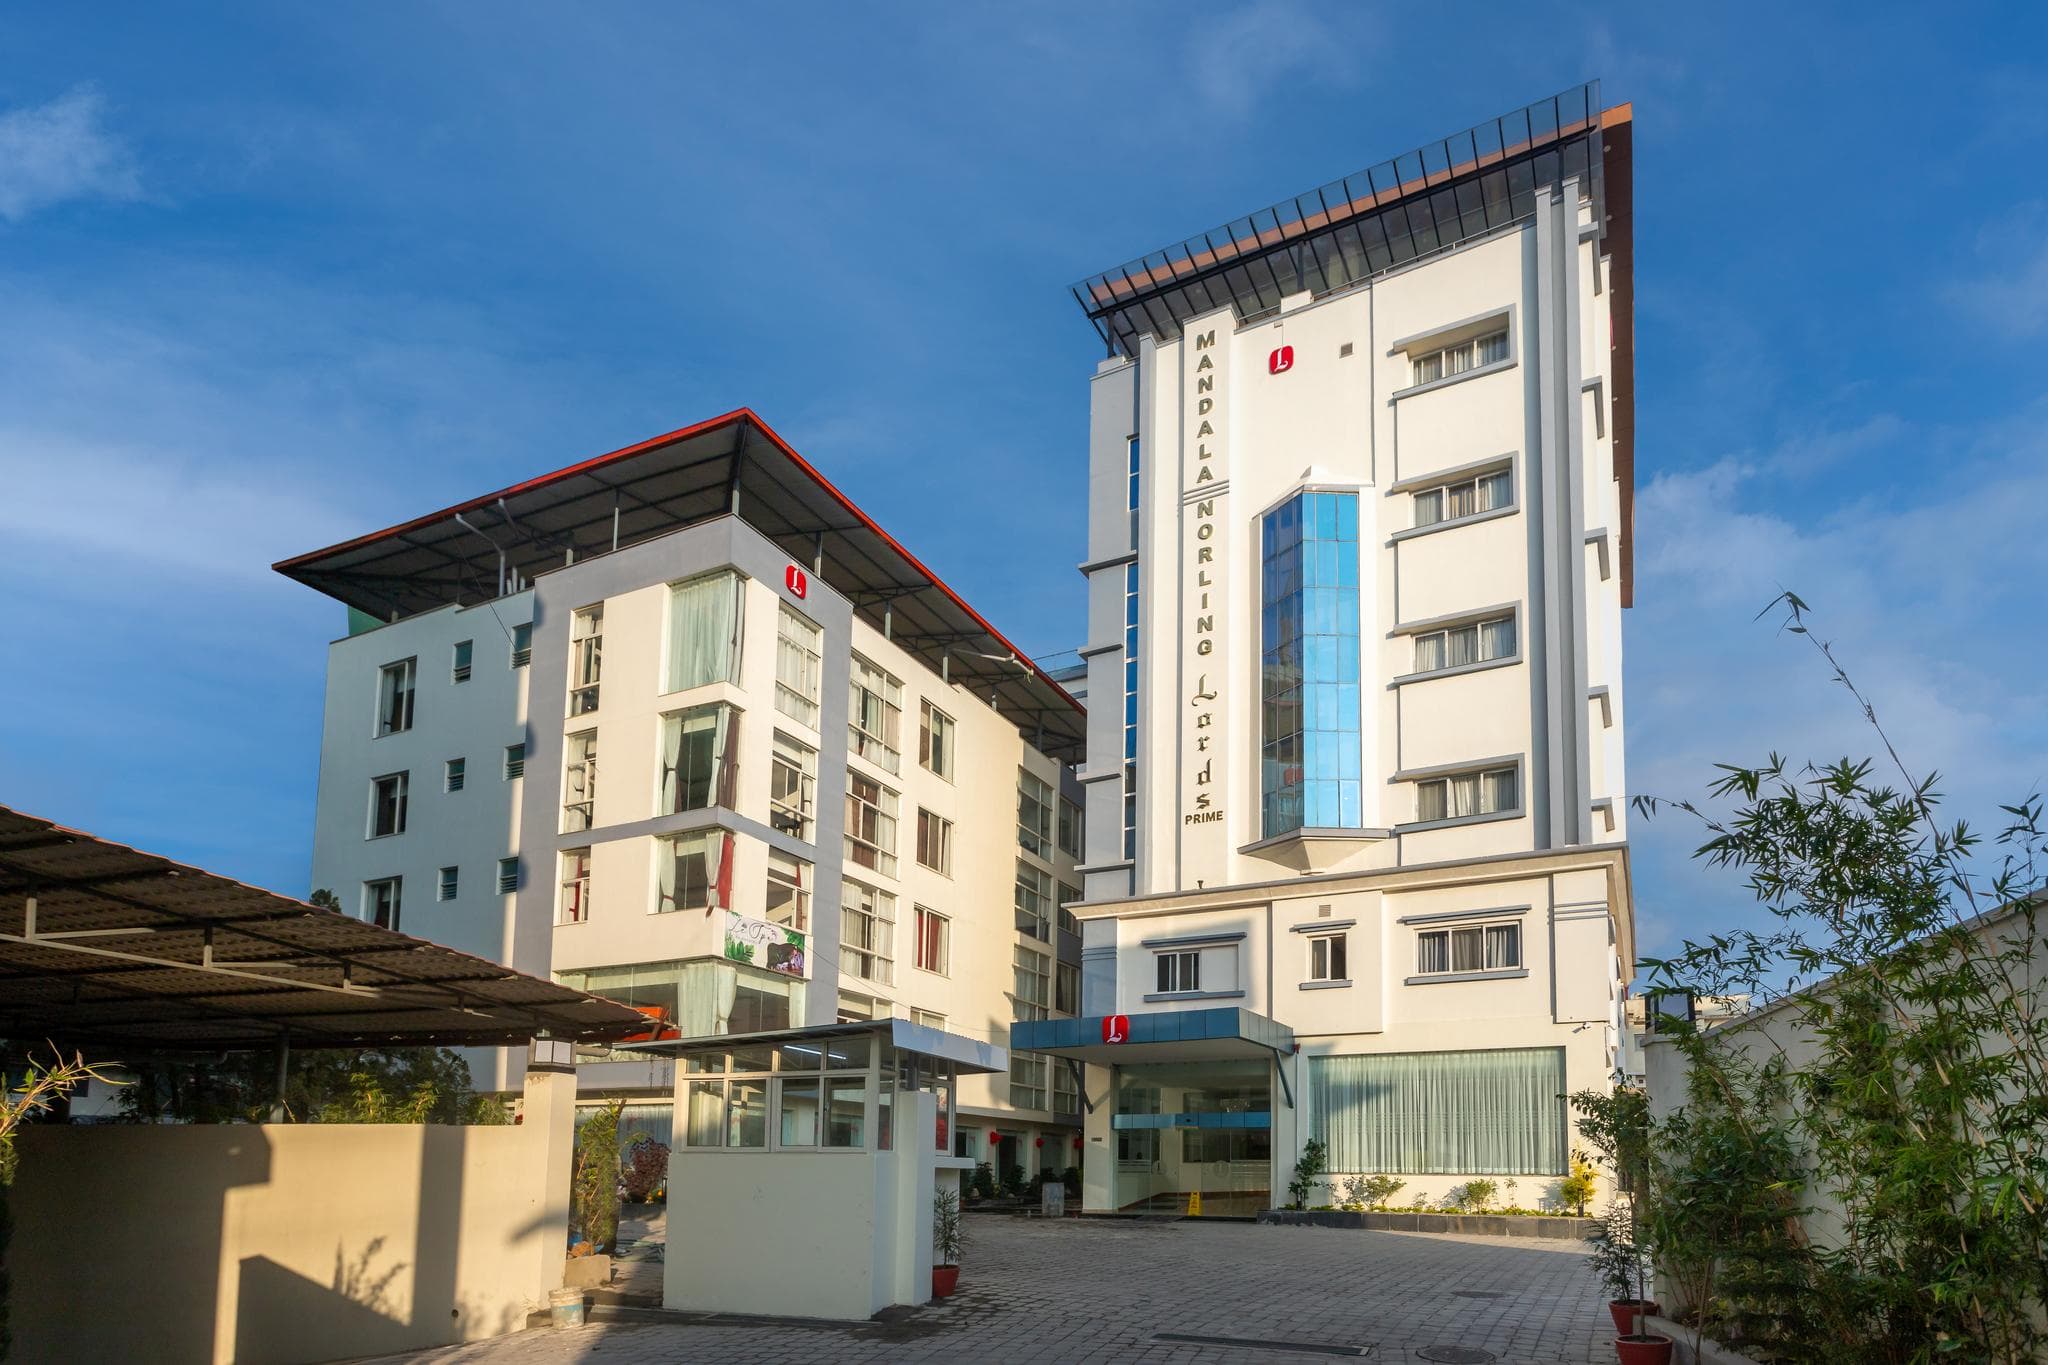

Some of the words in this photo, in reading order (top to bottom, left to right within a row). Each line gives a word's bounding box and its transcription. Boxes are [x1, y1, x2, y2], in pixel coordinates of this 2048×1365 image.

[1273, 347, 1289, 372] L
[1196, 329, 1216, 484] MANDALA
[789, 567, 803, 595] L
[1197, 500, 1214, 656] NORLING
[1191, 673, 1218, 810] Lords
[1184, 810, 1224, 825] PRIME
[1106, 1015, 1122, 1043] L
